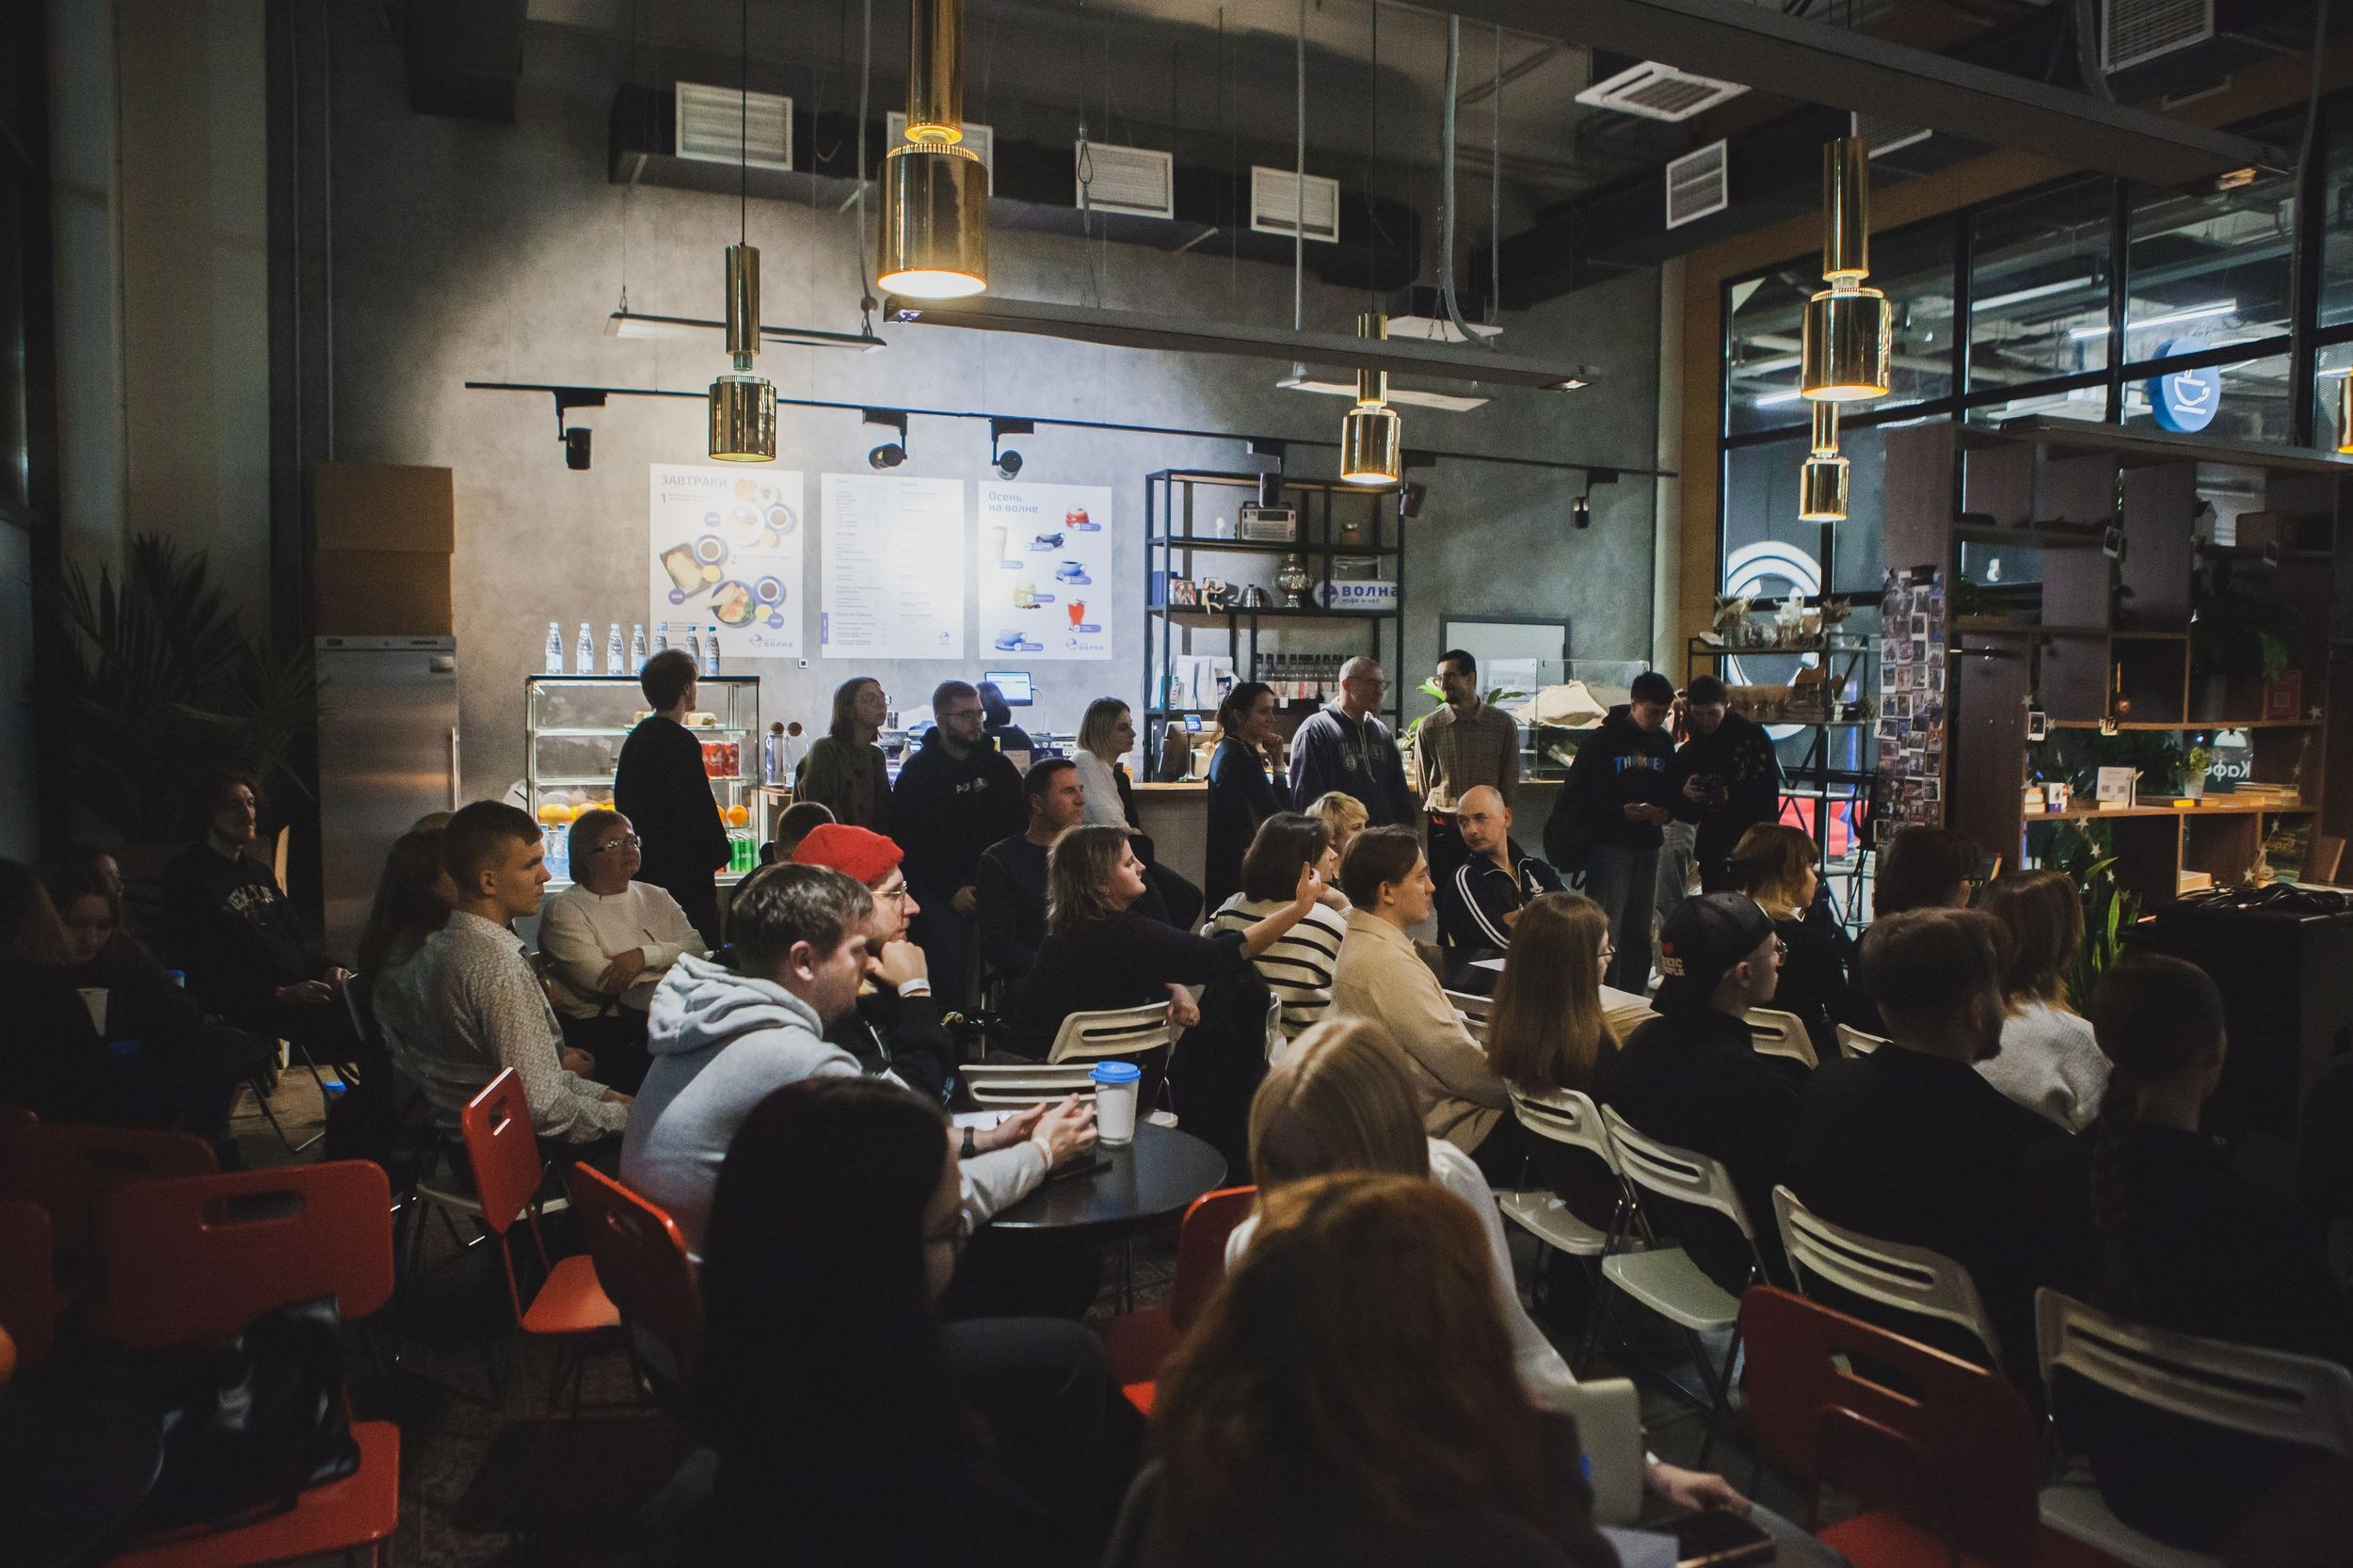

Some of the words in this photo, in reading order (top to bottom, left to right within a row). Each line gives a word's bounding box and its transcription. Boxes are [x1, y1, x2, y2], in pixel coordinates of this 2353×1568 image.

[662, 475, 728, 488] ЗАВТРАКИ
[988, 491, 1022, 502] Осень
[1005, 504, 1038, 513] волне
